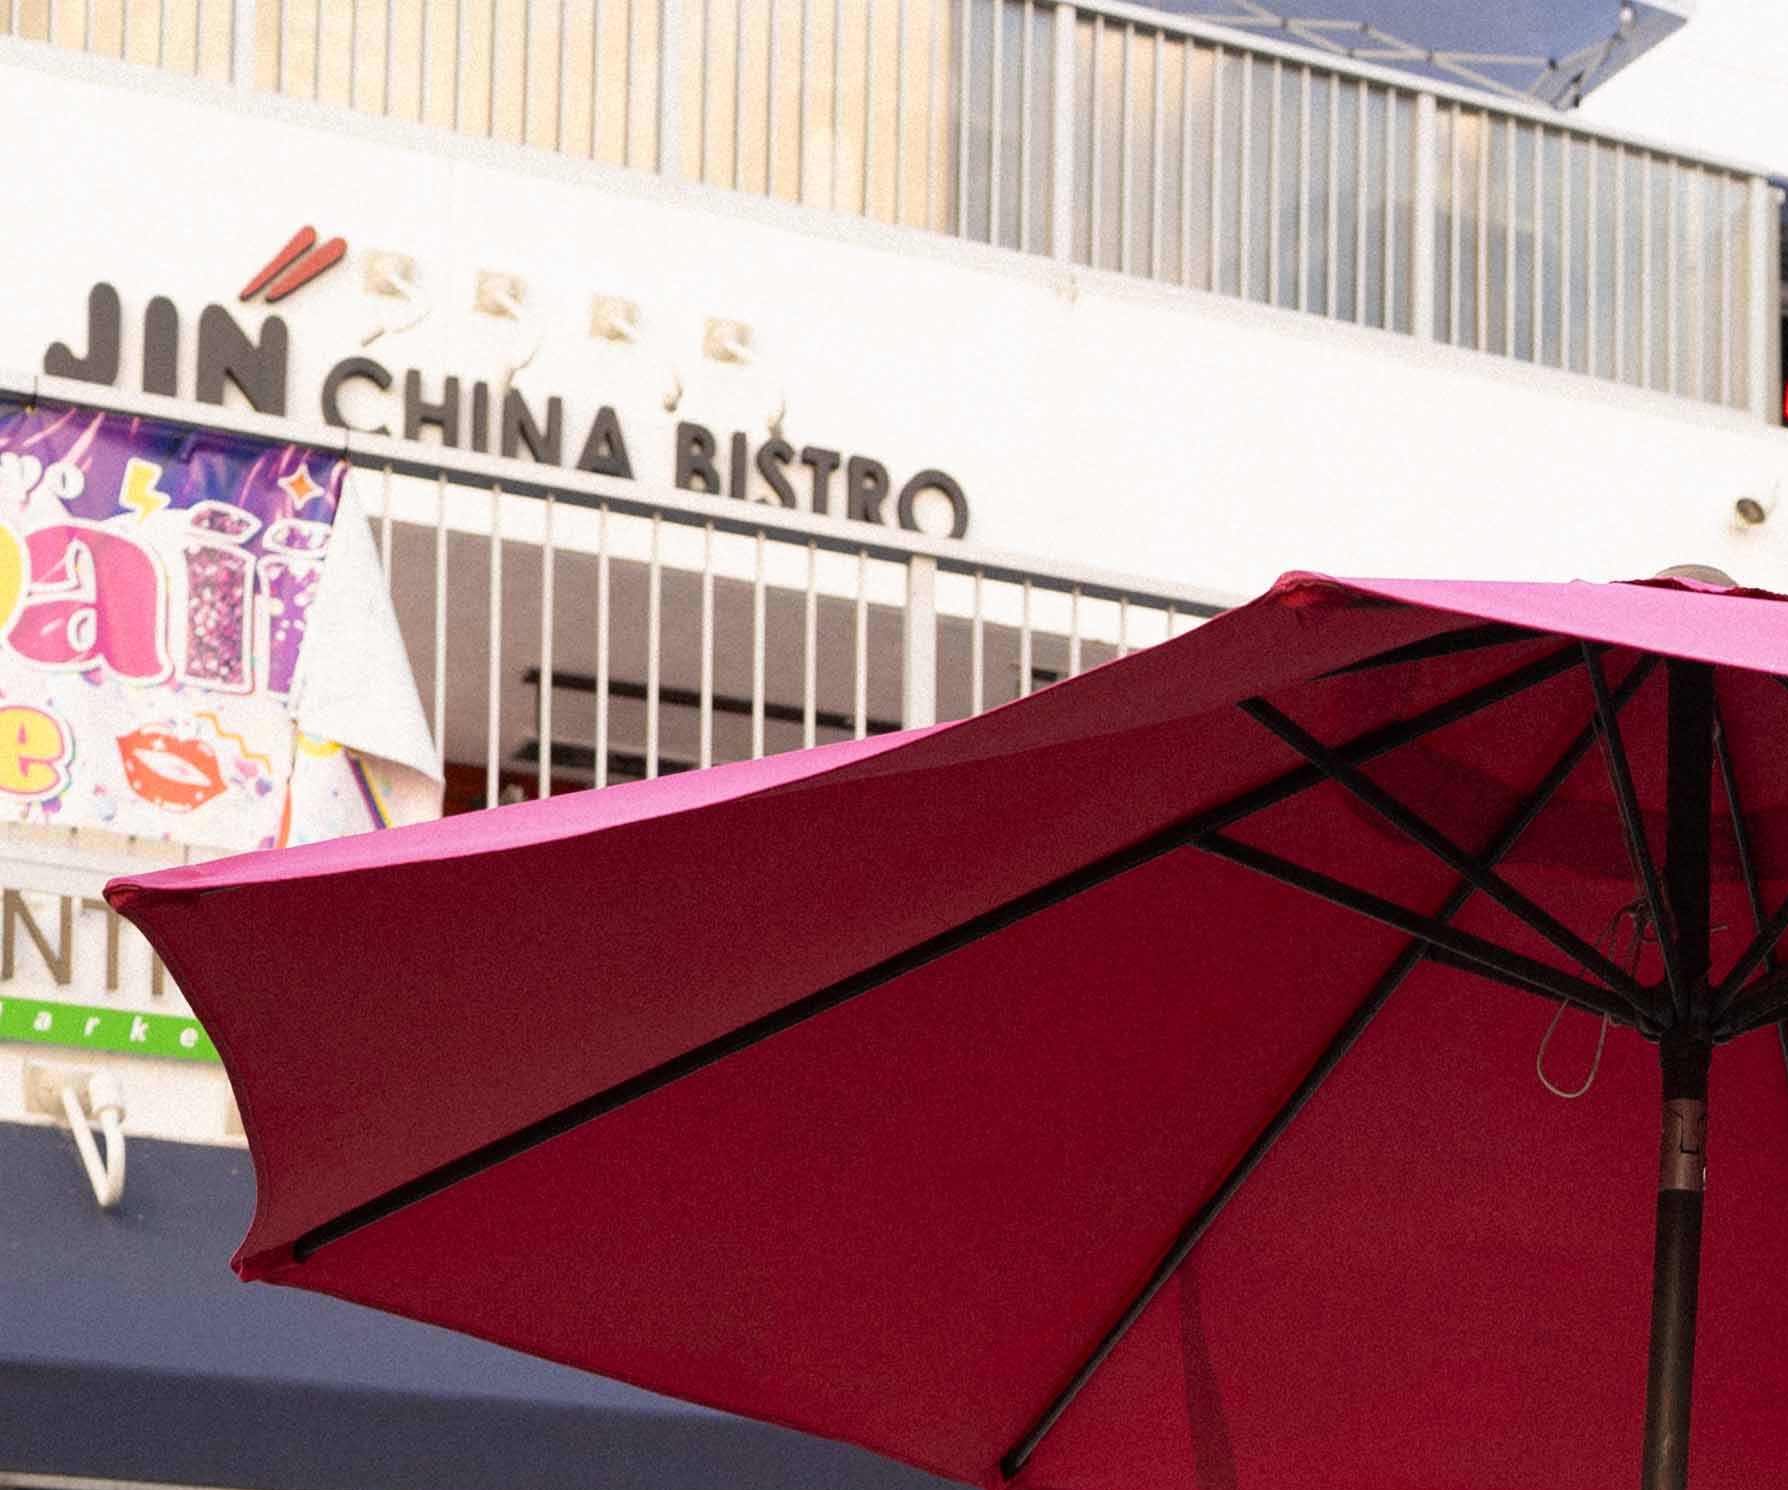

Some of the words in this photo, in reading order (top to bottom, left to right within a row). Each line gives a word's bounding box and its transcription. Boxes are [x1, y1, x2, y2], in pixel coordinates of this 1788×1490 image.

[44, 281, 288, 417] JIN
[322, 356, 634, 480] CHINA
[675, 421, 970, 540] BISTRO
[0, 501, 332, 700] aii
